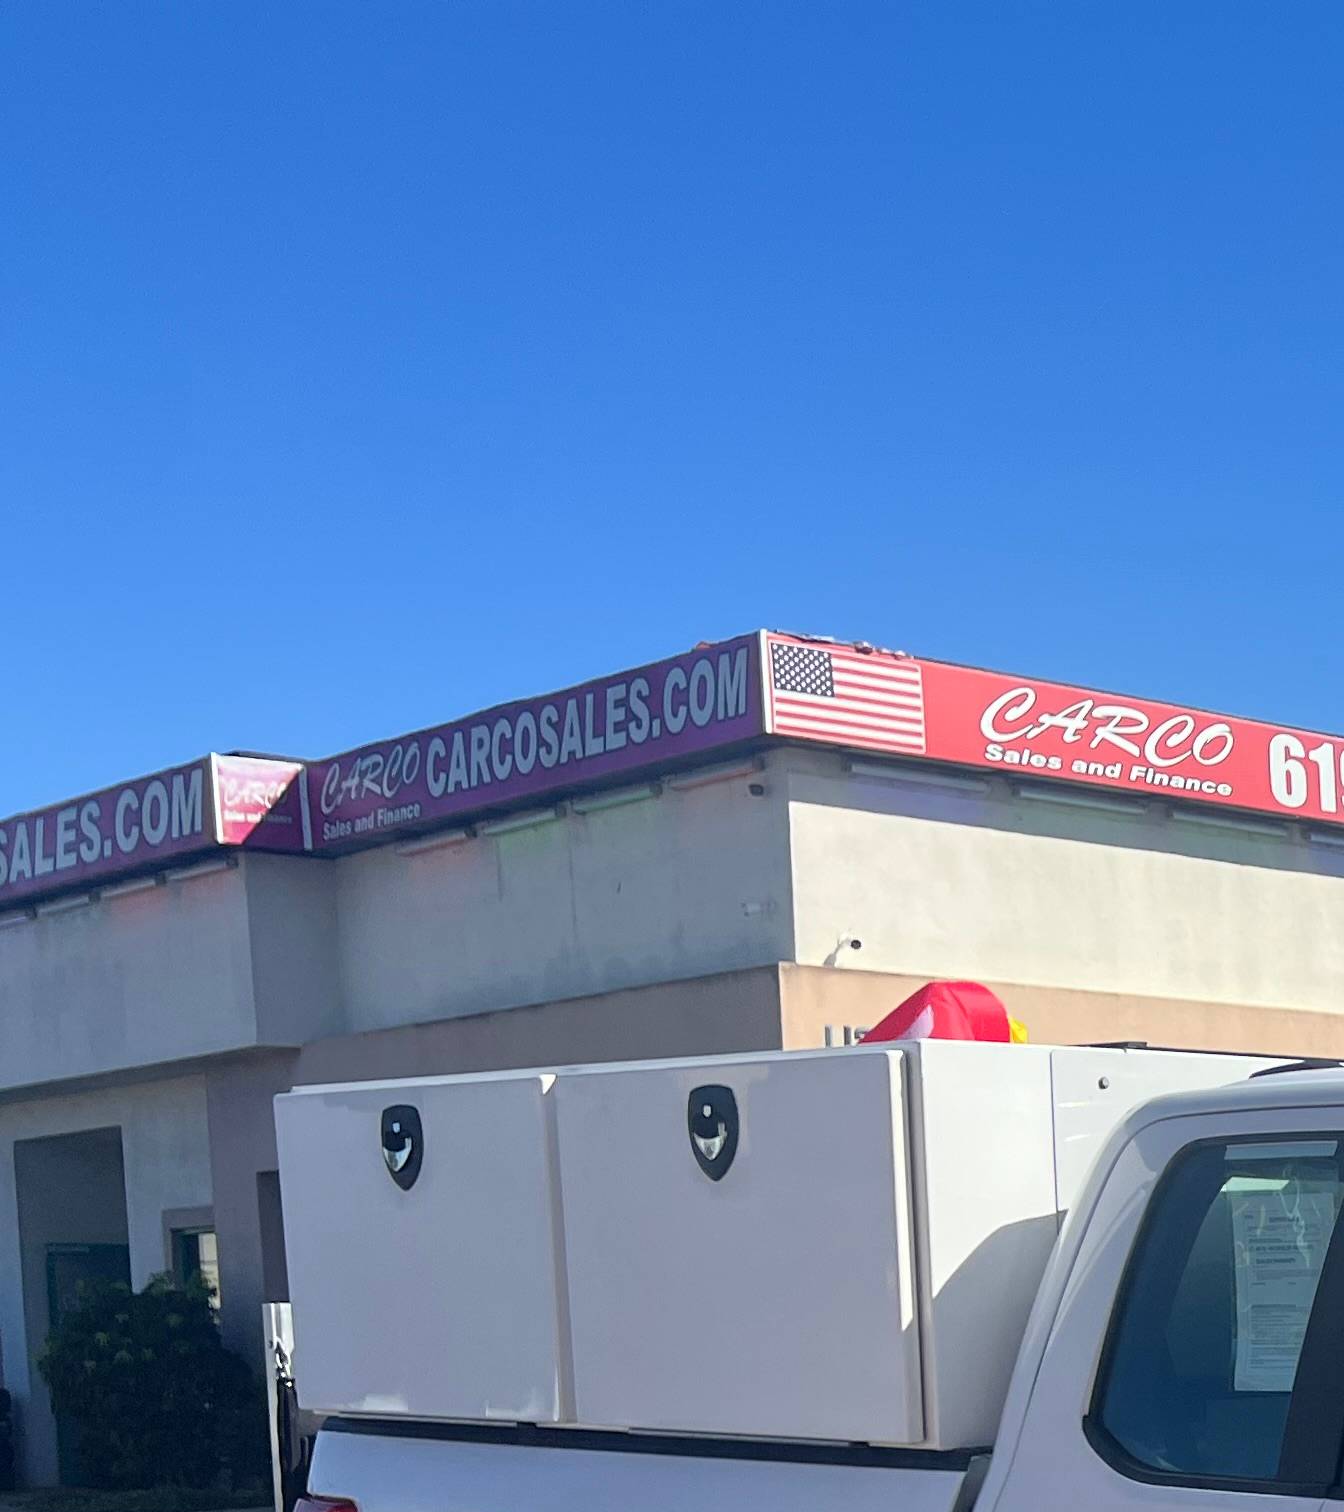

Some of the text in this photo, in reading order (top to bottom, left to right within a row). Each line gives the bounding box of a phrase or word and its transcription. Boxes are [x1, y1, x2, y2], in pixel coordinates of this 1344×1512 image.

[426, 646, 749, 798] CARCOSALES.COM
[979, 686, 1234, 768] CARCO
[320, 741, 421, 815] CARCO
[984, 742, 1233, 797] Sales and Finance
[323, 802, 421, 842] Sales and Finance
